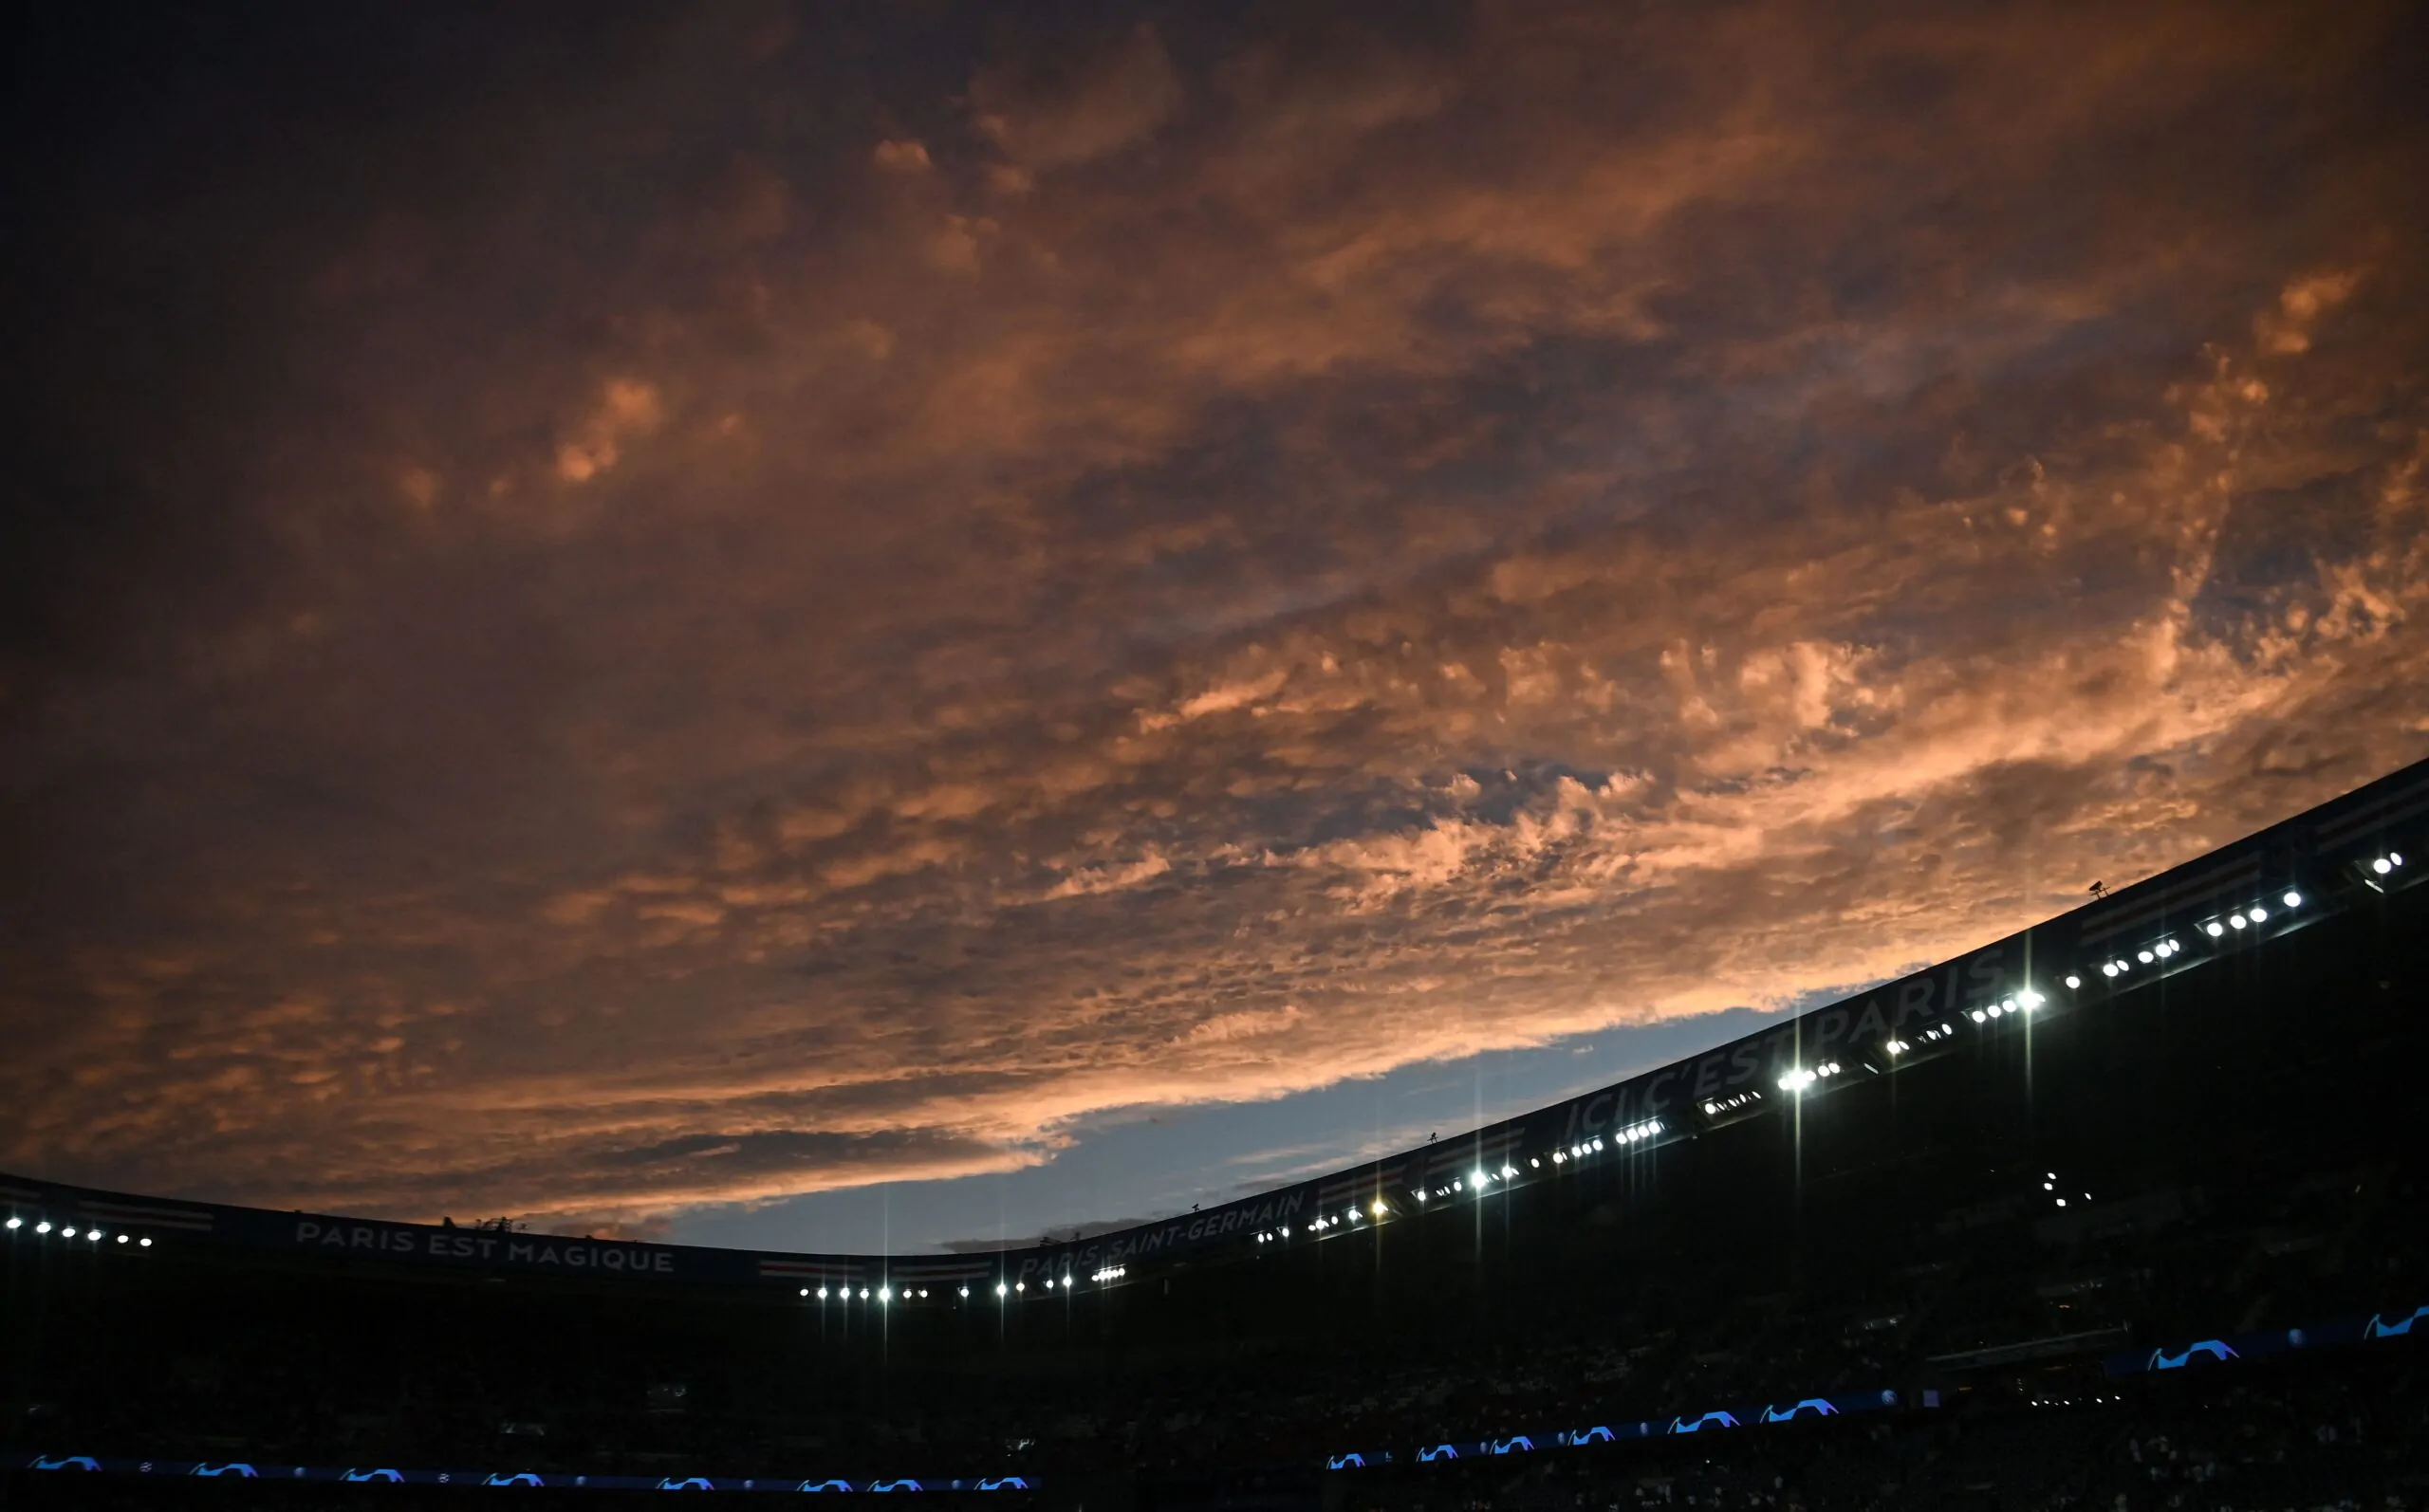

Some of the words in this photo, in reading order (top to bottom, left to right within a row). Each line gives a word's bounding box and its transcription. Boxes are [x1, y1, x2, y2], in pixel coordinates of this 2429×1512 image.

[1565, 1088, 1629, 1139] ICI
[1643, 1029, 1794, 1112] C'EST
[1814, 949, 2005, 1050] PARIS
[295, 1221, 417, 1253] PARIS
[428, 1233, 498, 1261] EST
[507, 1241, 676, 1273] MAGIQUE
[1018, 1244, 1101, 1278] PARIS
[1106, 1190, 1306, 1261] SAINT-GERMAIN
